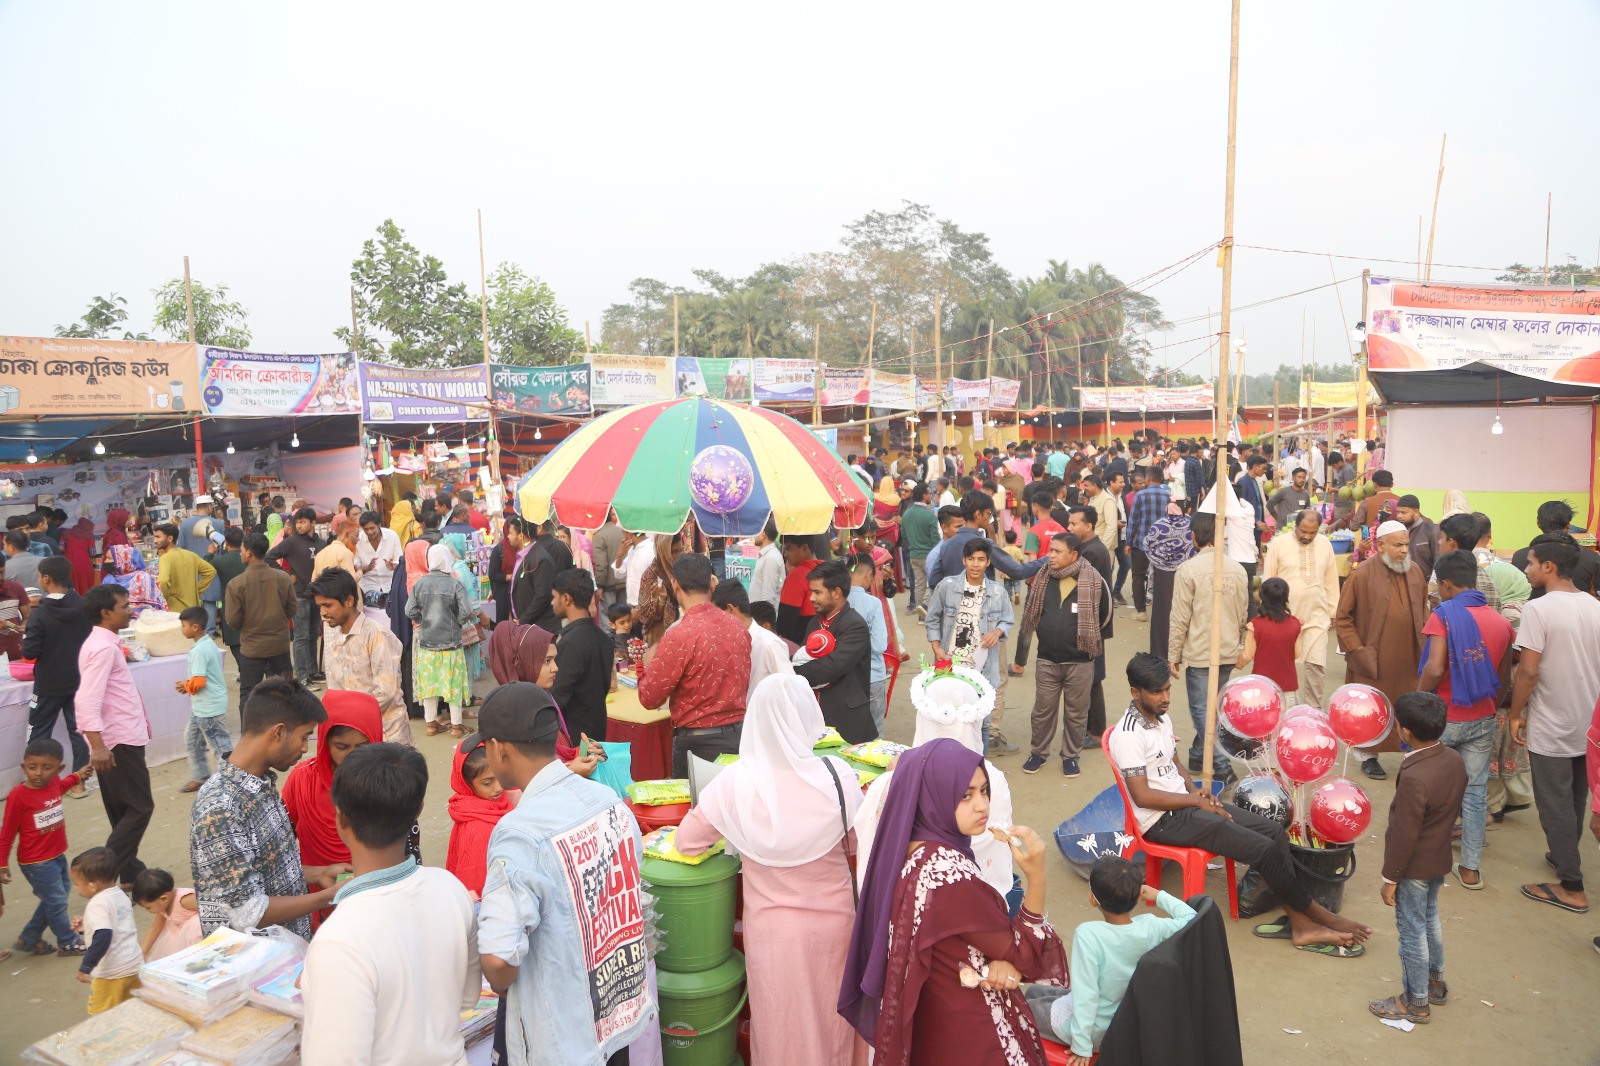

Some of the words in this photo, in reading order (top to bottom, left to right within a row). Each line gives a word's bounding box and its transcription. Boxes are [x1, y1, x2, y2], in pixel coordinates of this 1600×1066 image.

[1405, 313, 1467, 330] নুরুজ্জামান
[1470, 316, 1508, 332] মেম্বার
[1512, 319, 1552, 334] ফলের
[130, 357, 170, 378] হাউস
[207, 364, 252, 384] আমরিন
[257, 365, 313, 384] ক্রোকারীজ
[493, 367, 530, 388] সৌরভ
[531, 370, 568, 387] খেলনা
[569, 370, 588, 385] ঘর
[366, 380, 419, 398] NAZRUL'S
[419, 382, 442, 398] TOY
[443, 381, 487, 398] WORLD
[397, 405, 460, 416] CHATTOGRAM
[28, 475, 54, 487] হাউস
[1239, 701, 1271, 716] LOVE
[1326, 810, 1360, 832] LOVE
[569, 828, 588, 845] BLACK
[573, 835, 599, 865] 2018
[631, 924, 644, 935] LIV
